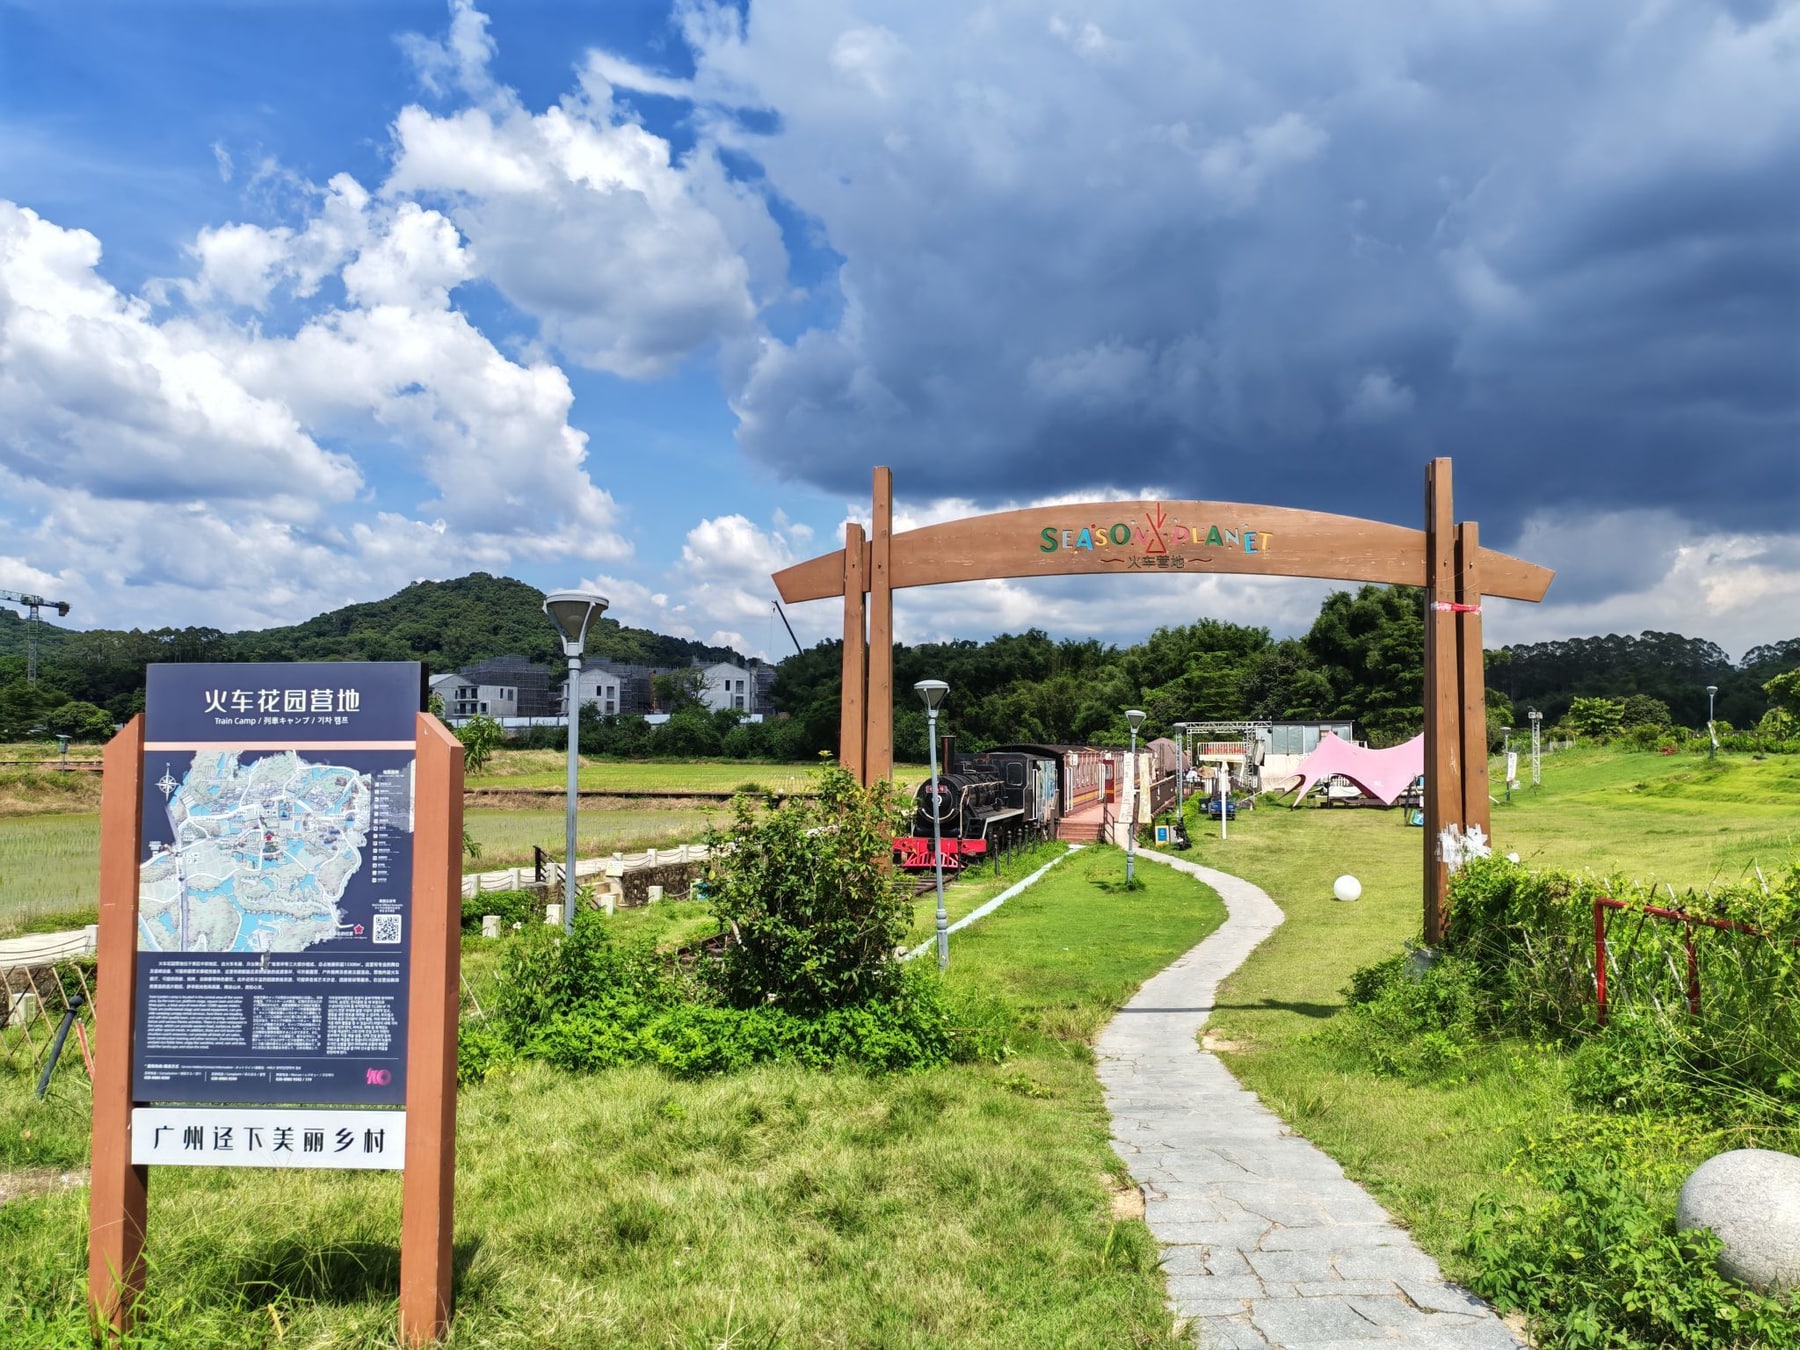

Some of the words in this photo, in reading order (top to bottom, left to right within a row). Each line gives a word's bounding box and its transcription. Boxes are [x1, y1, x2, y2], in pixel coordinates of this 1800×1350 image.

[1040, 523, 1149, 554] SEASON
[1171, 524, 1273, 554] PLANET
[1128, 555, 1185, 569] 火车营地
[204, 688, 360, 713] 火车花园营地
[214, 716, 233, 725] Train
[234, 717, 256, 726] Camp
